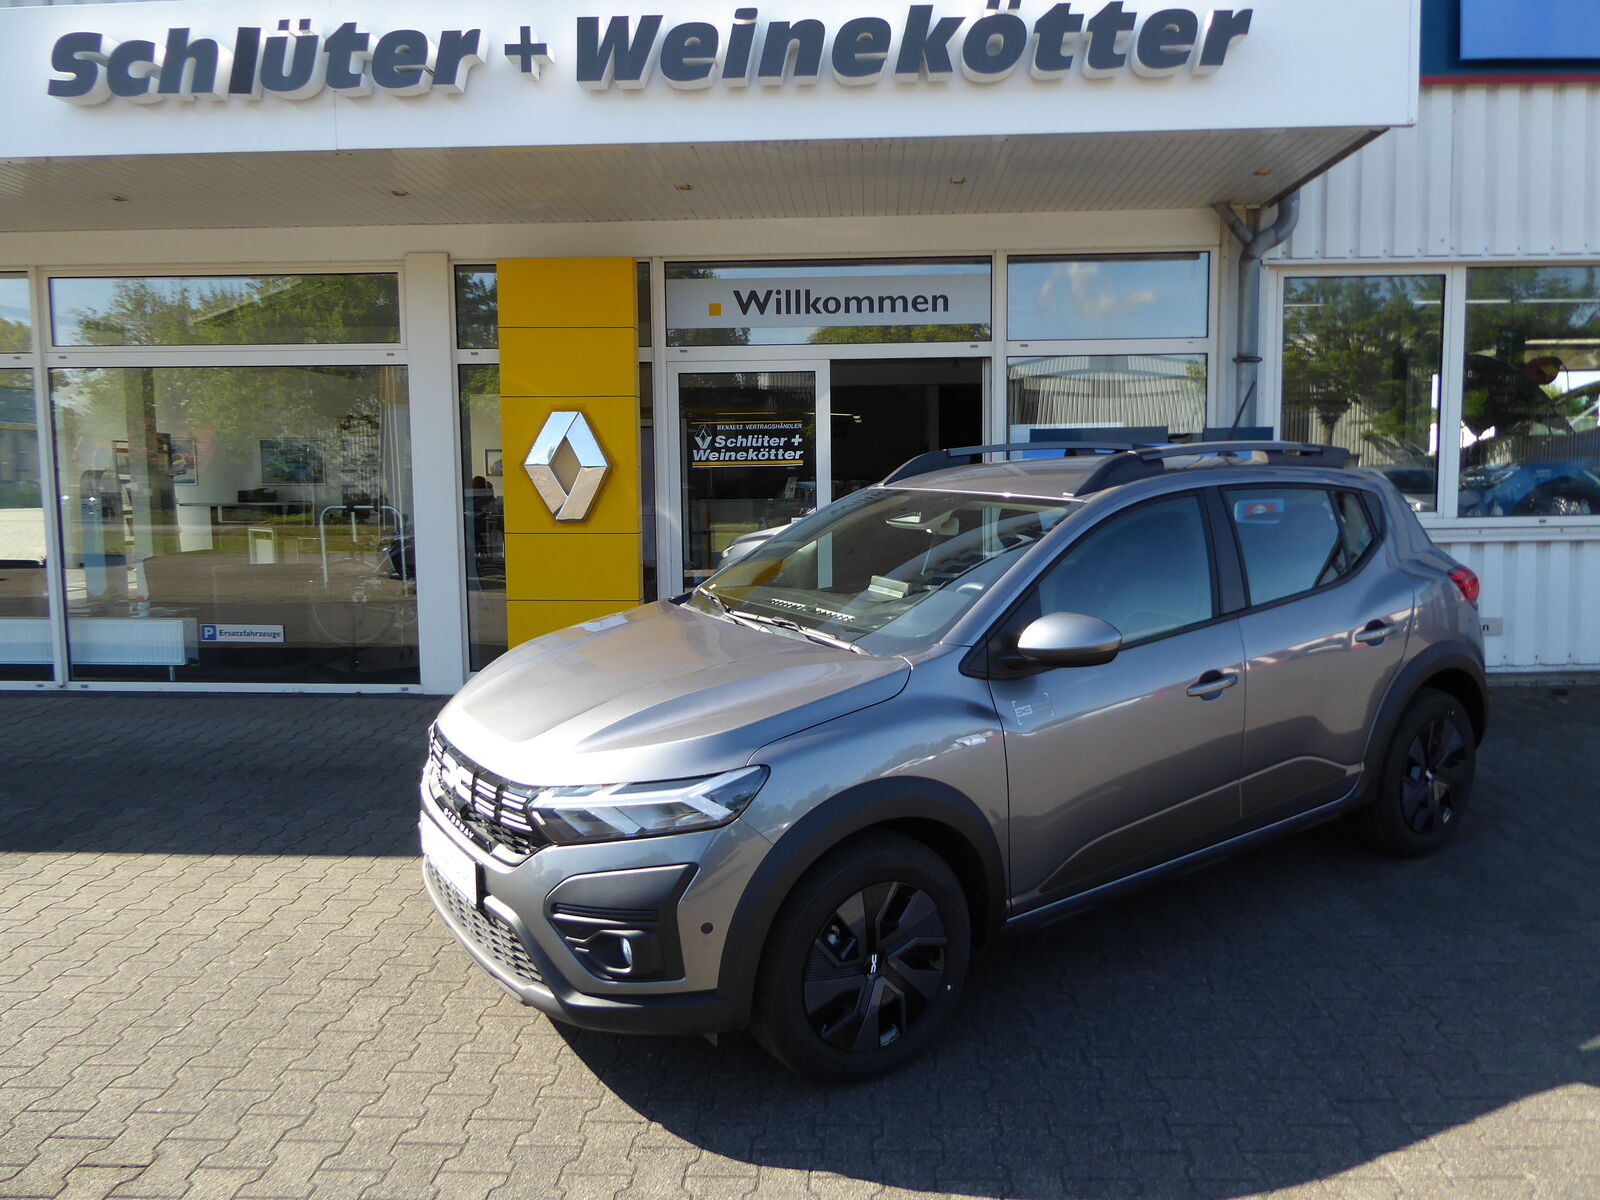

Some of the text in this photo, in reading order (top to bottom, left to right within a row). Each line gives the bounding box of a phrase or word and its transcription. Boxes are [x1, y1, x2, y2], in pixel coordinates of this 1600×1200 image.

[48, 0, 1254, 99] Schlüter + Weinekötter
[732, 288, 950, 316] Willkommen
[745, 422, 803, 431] VERTRAGSHÄNDLER
[714, 434, 803, 448] Schlüter +
[692, 448, 804, 461] Weinekötter
[219, 629, 281, 639] Ersatzfahrzeuge
